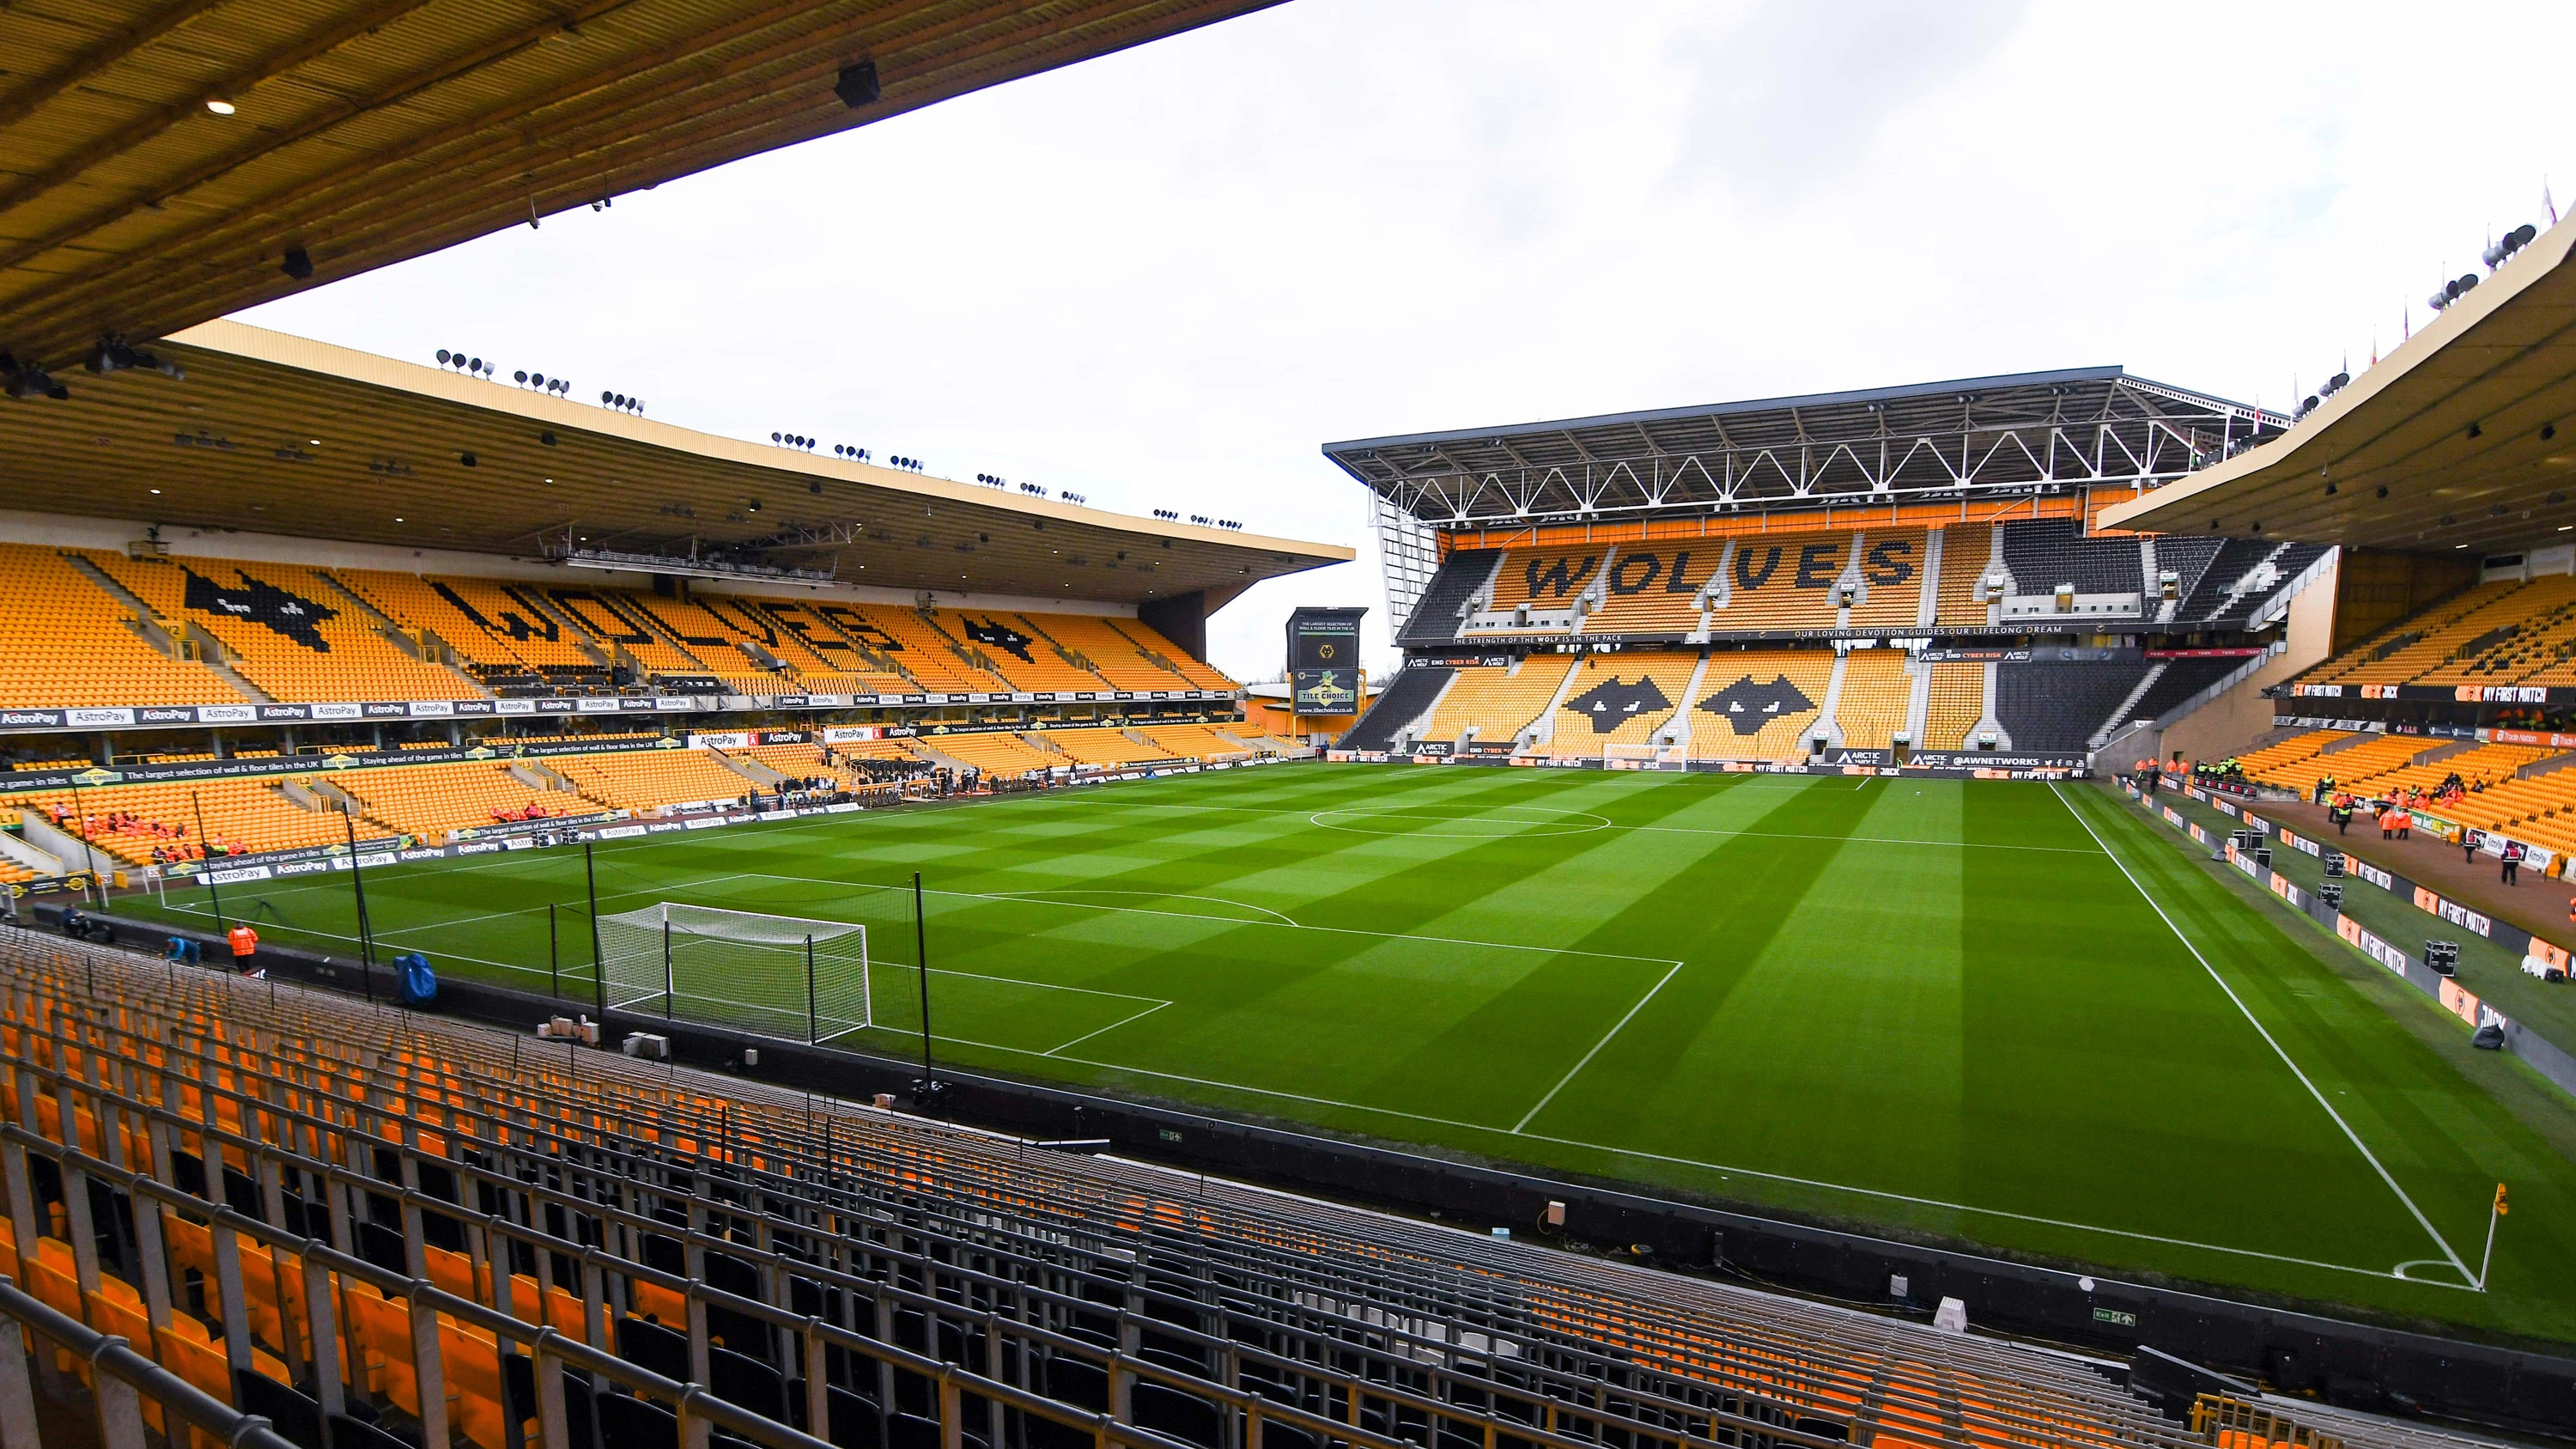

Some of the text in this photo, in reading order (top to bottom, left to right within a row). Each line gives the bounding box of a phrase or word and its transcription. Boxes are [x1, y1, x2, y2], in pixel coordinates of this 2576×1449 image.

[1526, 540, 1913, 598] WOLVES
[2483, 687, 2547, 703] MY FIRST MATCH
[368, 704, 404, 715] AstroPay
[416, 703, 448, 714] AstroPay
[459, 702, 490, 713] AstroPay
[500, 701, 529, 712] AstroPay
[541, 701, 572, 711] AstroPay
[586, 700, 615, 709] AstroPay
[623, 699, 653, 709] AstroPay
[143, 709, 191, 721] AstroPay
[206, 708, 249, 720] AstroPay
[264, 707, 306, 719] AstroPay
[318, 704, 356, 716] AstroPay
[2, 713, 58, 725] AstroPay
[76, 710, 125, 723] AstroPay
[768, 732, 802, 743] AstroPay
[835, 729, 864, 740] AstroPay
[890, 727, 917, 737] AstroPay
[701, 735, 737, 746] AstroPay
[2505, 733, 2537, 743] Trade Nation
[1563, 759, 1582, 768] MATCH
[1953, 757, 2039, 766] @AWNETWORKS
[126, 771, 144, 780] The
[146, 770, 173, 780] largest
[175, 768, 212, 777] selection
[240, 764, 247, 773] &
[268, 763, 283, 771] tiles
[1765, 764, 1784, 773] FIRST
[1880, 768, 1900, 776] JACK
[2071, 770, 2084, 778] MY
[7, 780, 34, 789] game
[46, 776, 69, 785] tiles
[649, 821, 682, 832] AstroPay
[690, 818, 721, 828] AstroPay
[491, 826, 509, 835] largest
[606, 826, 641, 837] AstroPay
[459, 843, 498, 854] AstroPay
[400, 848, 445, 861] AstroPay
[234, 857, 256, 866] ahead
[278, 855, 297, 864] game
[276, 862, 326, 874] AstroPay
[2439, 898, 2490, 938] MY FIRST MATCH
[2360, 928, 2406, 977] MY FIRST MATCH
[2096, 1311, 2110, 1319] Exit
